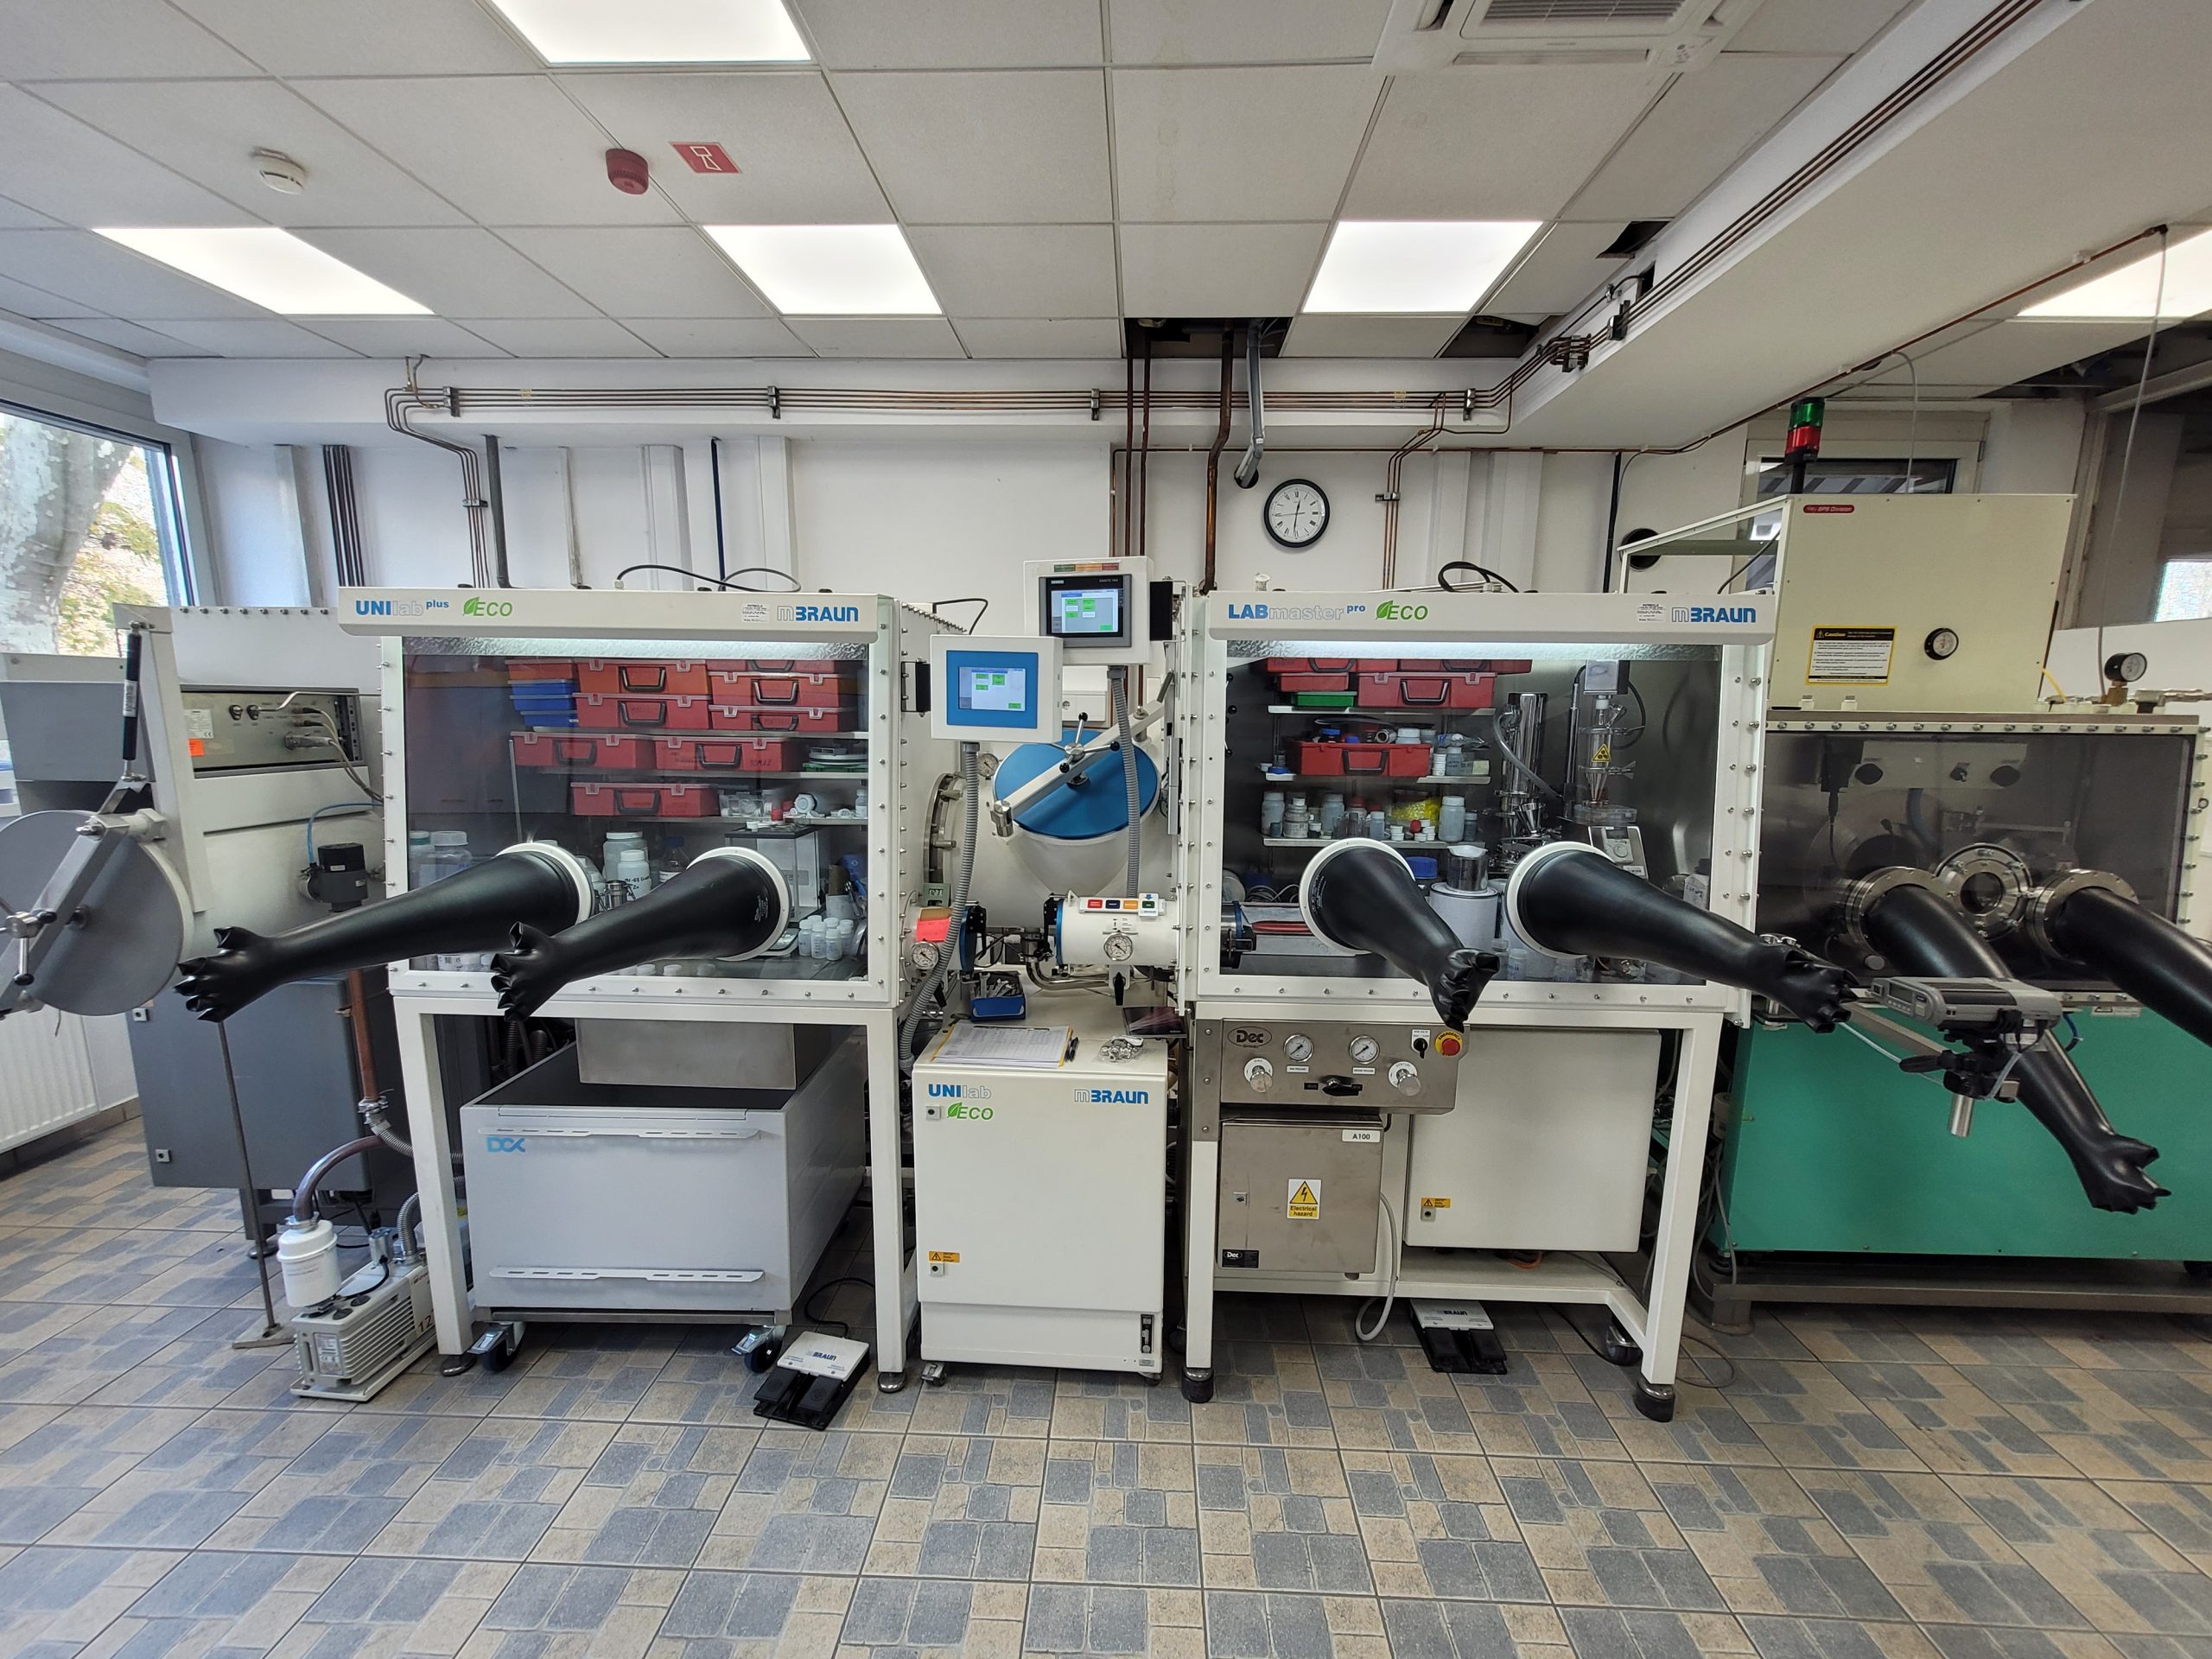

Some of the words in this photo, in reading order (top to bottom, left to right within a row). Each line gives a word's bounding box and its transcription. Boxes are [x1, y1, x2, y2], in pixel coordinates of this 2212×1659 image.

[426, 600, 449, 610] plus
[473, 601, 513, 617] ECO
[1228, 604, 1344, 620] LABmaster
[1346, 605, 1366, 614] pro
[1386, 605, 1428, 620] ECO
[1236, 1029, 1264, 1044] Dec
[1438, 1032, 1461, 1041] EMERGENCY
[957, 1106, 994, 1121] ECO
